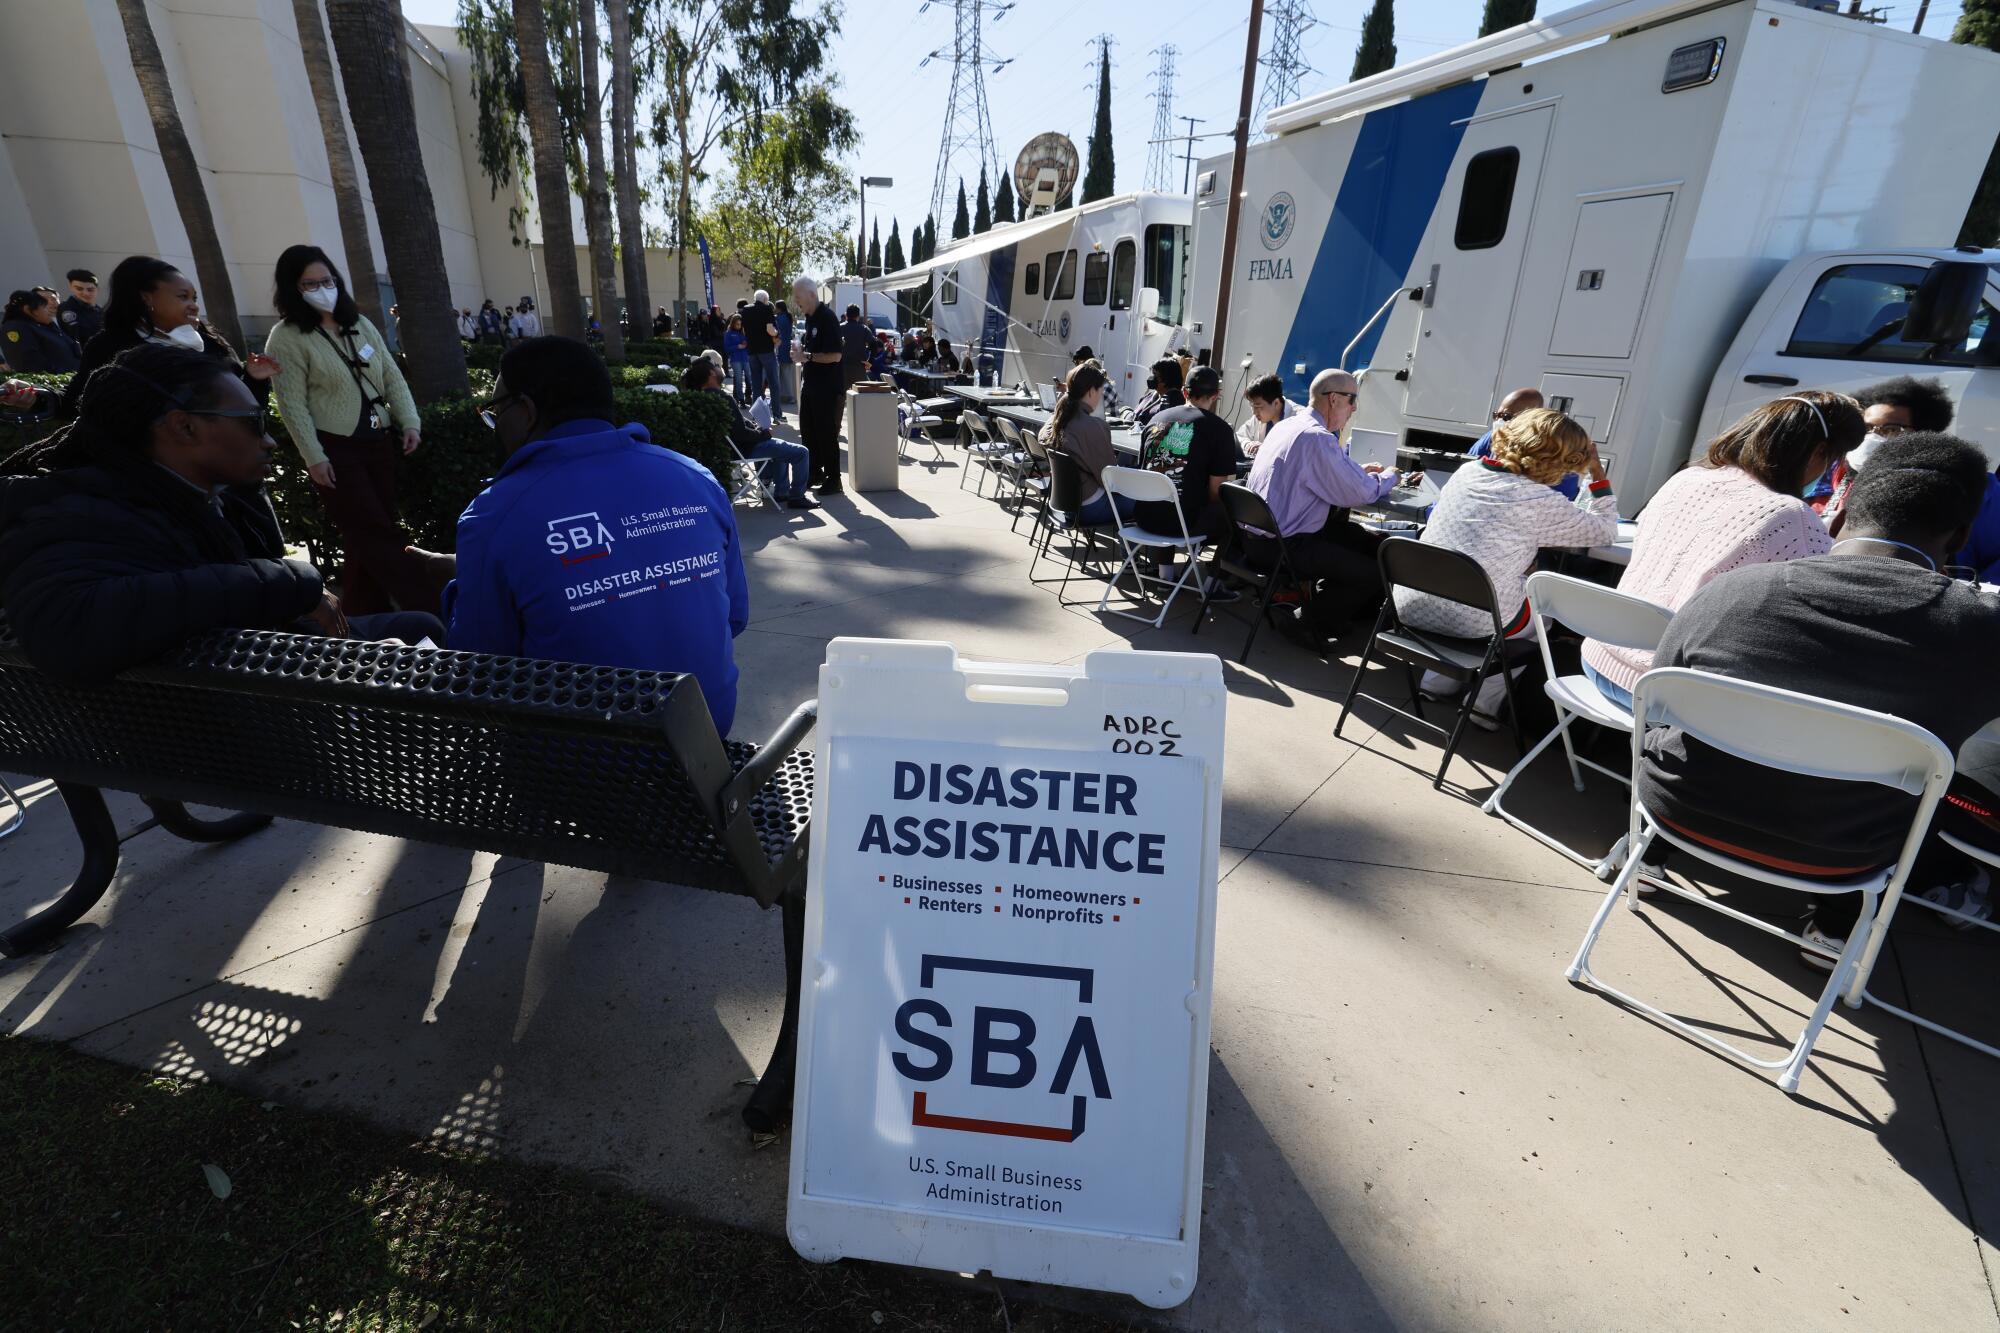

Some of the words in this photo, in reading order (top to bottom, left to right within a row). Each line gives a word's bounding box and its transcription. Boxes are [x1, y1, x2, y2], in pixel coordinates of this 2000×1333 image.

[1248, 258, 1294, 281] FEMA
[620, 515, 640, 526] U.S.
[642, 508, 670, 522] Small
[672, 504, 708, 516] Business
[626, 517, 696, 539] Administration
[546, 522, 615, 555] SBA
[564, 569, 641, 600] DISASTER
[645, 551, 719, 580] ASSISTANCE
[570, 598, 605, 612] Businesses
[618, 584, 657, 599] Homeowners
[1103, 714, 1181, 738] ADRC
[1112, 738, 1183, 757] 002
[893, 760, 1138, 816] DISASTER
[857, 814, 1166, 875] ASSISTANCE
[892, 874, 983, 895] Businesses
[1012, 883, 1126, 907] Homeowners
[918, 895, 982, 915] Renters
[1011, 903, 1104, 925] Nonprofits
[891, 998, 1113, 1100] SBA
[908, 1156, 940, 1176] U.S.
[945, 1160, 996, 1182] Small
[1002, 1167, 1083, 1191] Business
[926, 1182, 1063, 1214] Administration
